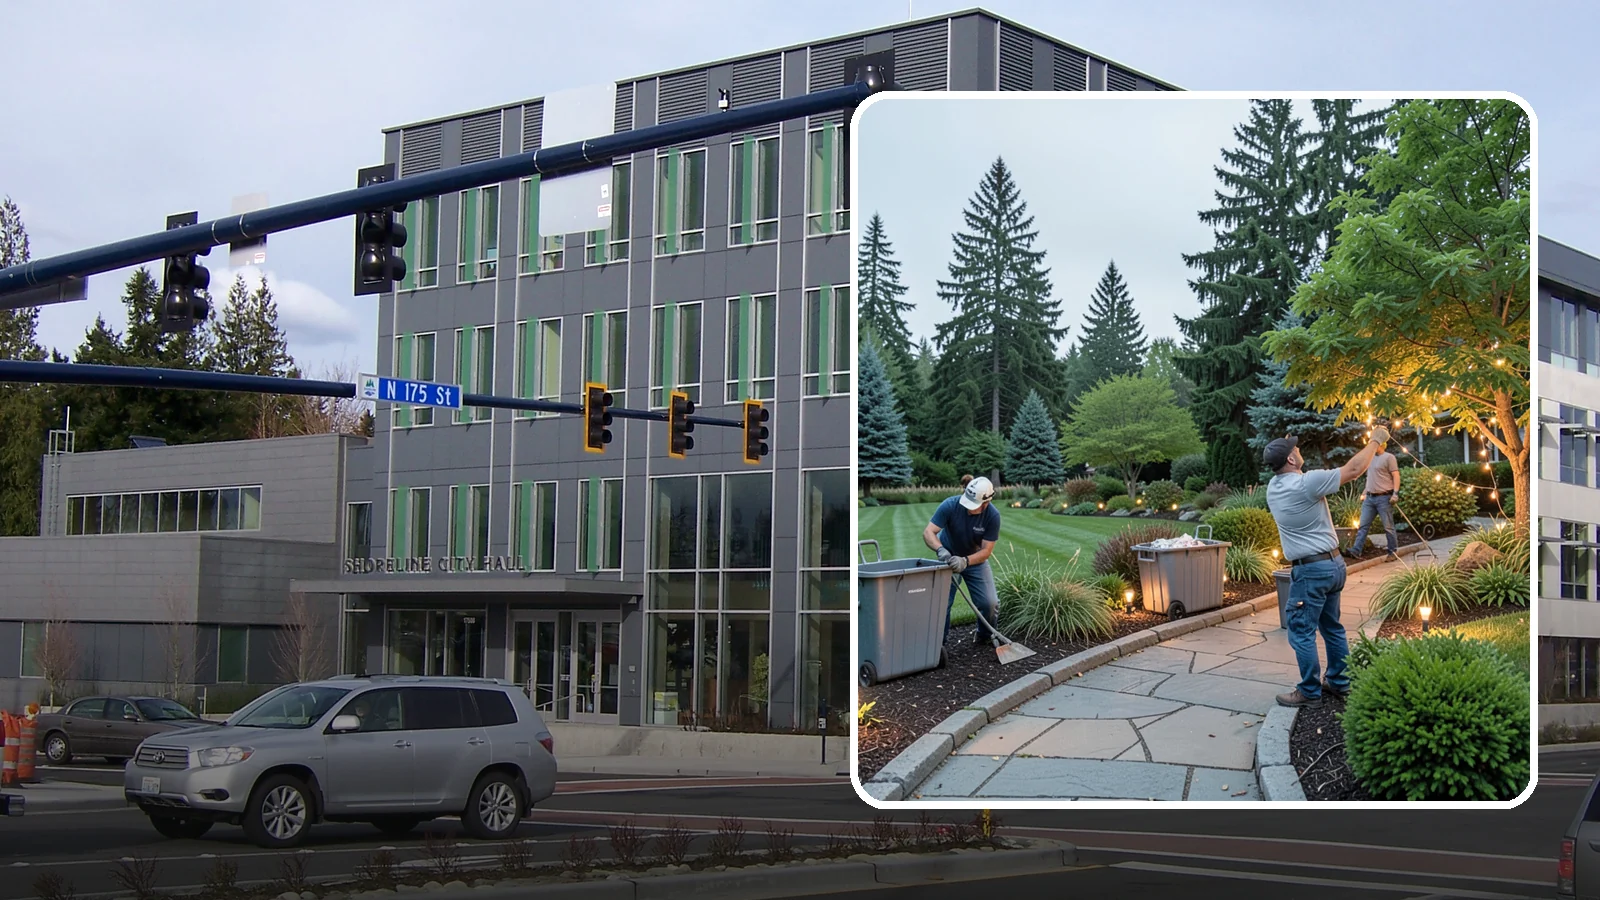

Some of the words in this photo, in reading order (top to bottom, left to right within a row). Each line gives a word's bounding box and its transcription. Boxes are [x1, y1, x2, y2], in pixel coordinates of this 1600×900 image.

[387, 380, 396, 400] N
[405, 382, 428, 403] 175
[436, 386, 451, 406] St
[344, 558, 432, 574] SHORELINE
[438, 557, 476, 573] CITY
[484, 556, 526, 573] HALL
